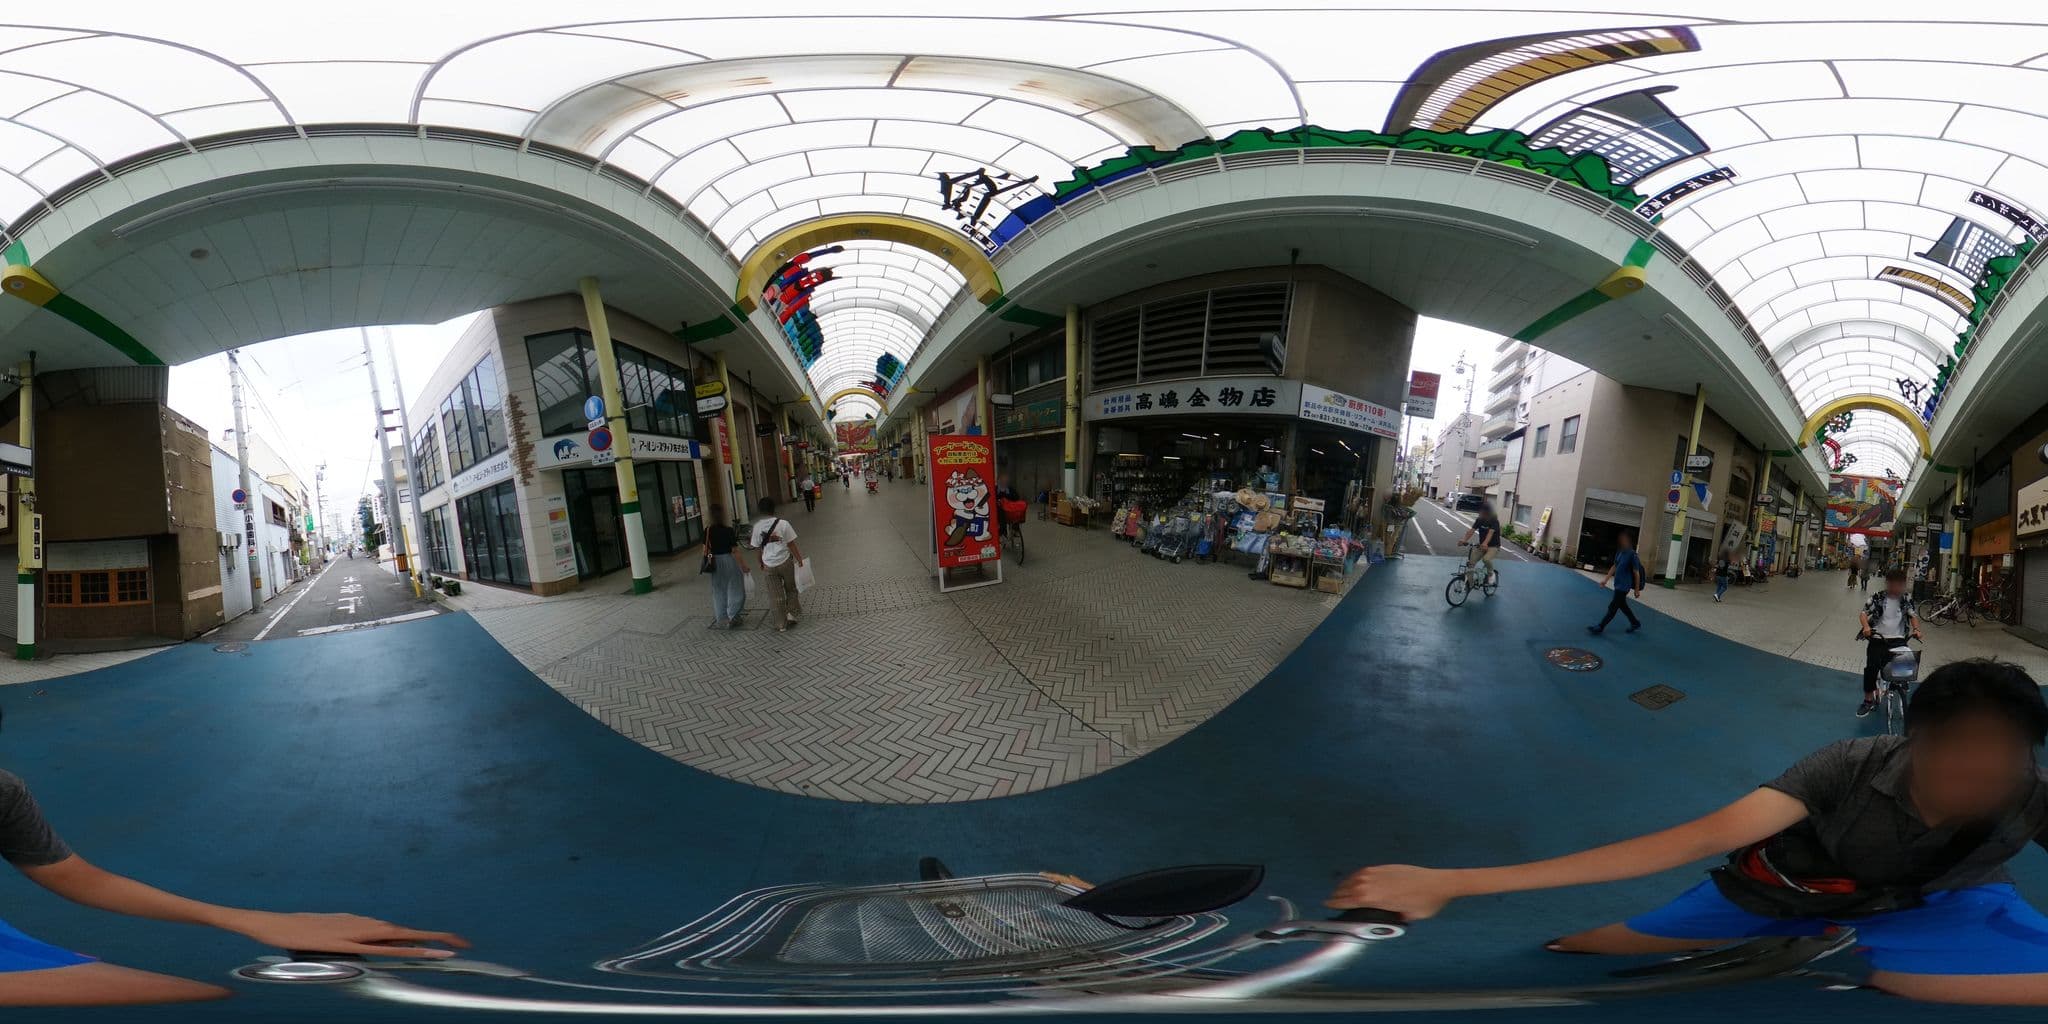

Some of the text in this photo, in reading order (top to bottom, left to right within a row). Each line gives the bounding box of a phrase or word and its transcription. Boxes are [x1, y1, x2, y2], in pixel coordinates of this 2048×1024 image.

[1639, 168, 1731, 217] サンポート高松
[1135, 387, 1277, 411] 高嶋金物店
